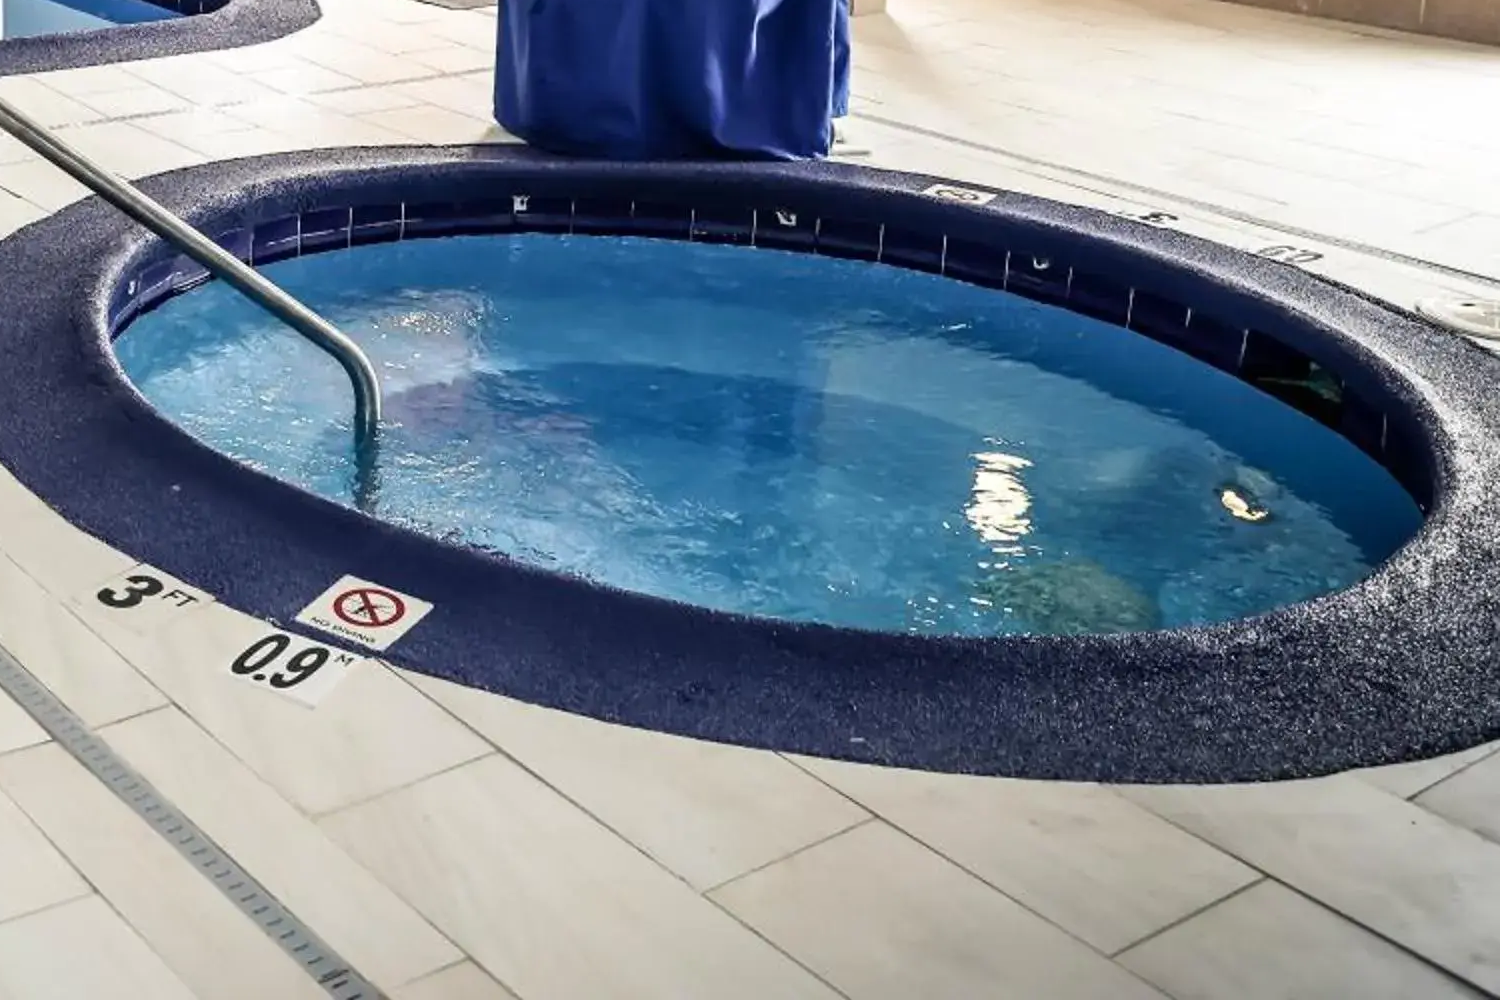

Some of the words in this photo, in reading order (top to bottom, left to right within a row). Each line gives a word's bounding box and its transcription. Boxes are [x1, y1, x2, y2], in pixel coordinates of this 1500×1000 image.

[97, 575, 163, 609] 3
[162, 589, 199, 608] FT
[310, 616, 331, 627] NO
[332, 625, 376, 644] DIVING
[231, 633, 330, 689] 0.9
[334, 653, 355, 667] M
